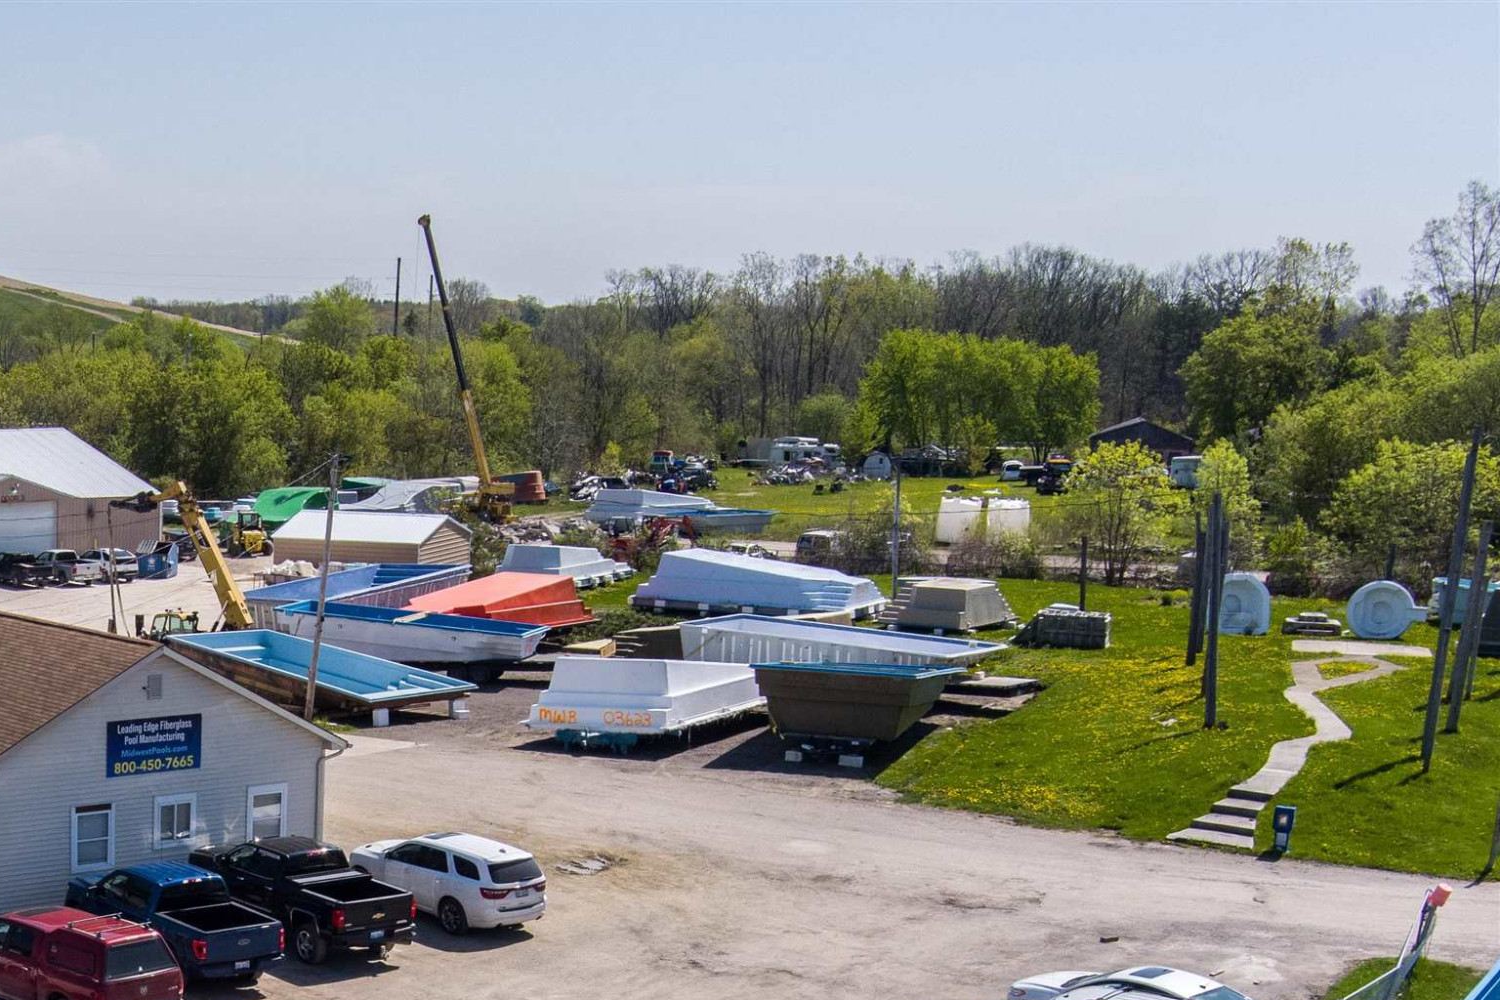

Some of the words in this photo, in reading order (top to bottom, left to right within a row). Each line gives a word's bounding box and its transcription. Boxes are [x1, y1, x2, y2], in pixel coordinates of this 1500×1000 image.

[117, 724, 143, 735] Leading
[143, 721, 159, 733] Edge
[160, 719, 192, 731] Fiberglass
[124, 735, 138, 745] Pool
[139, 731, 185, 743] Manufacturing
[121, 745, 188, 758] MidwestPools.com
[113, 755, 194, 774] 800-450-7665
